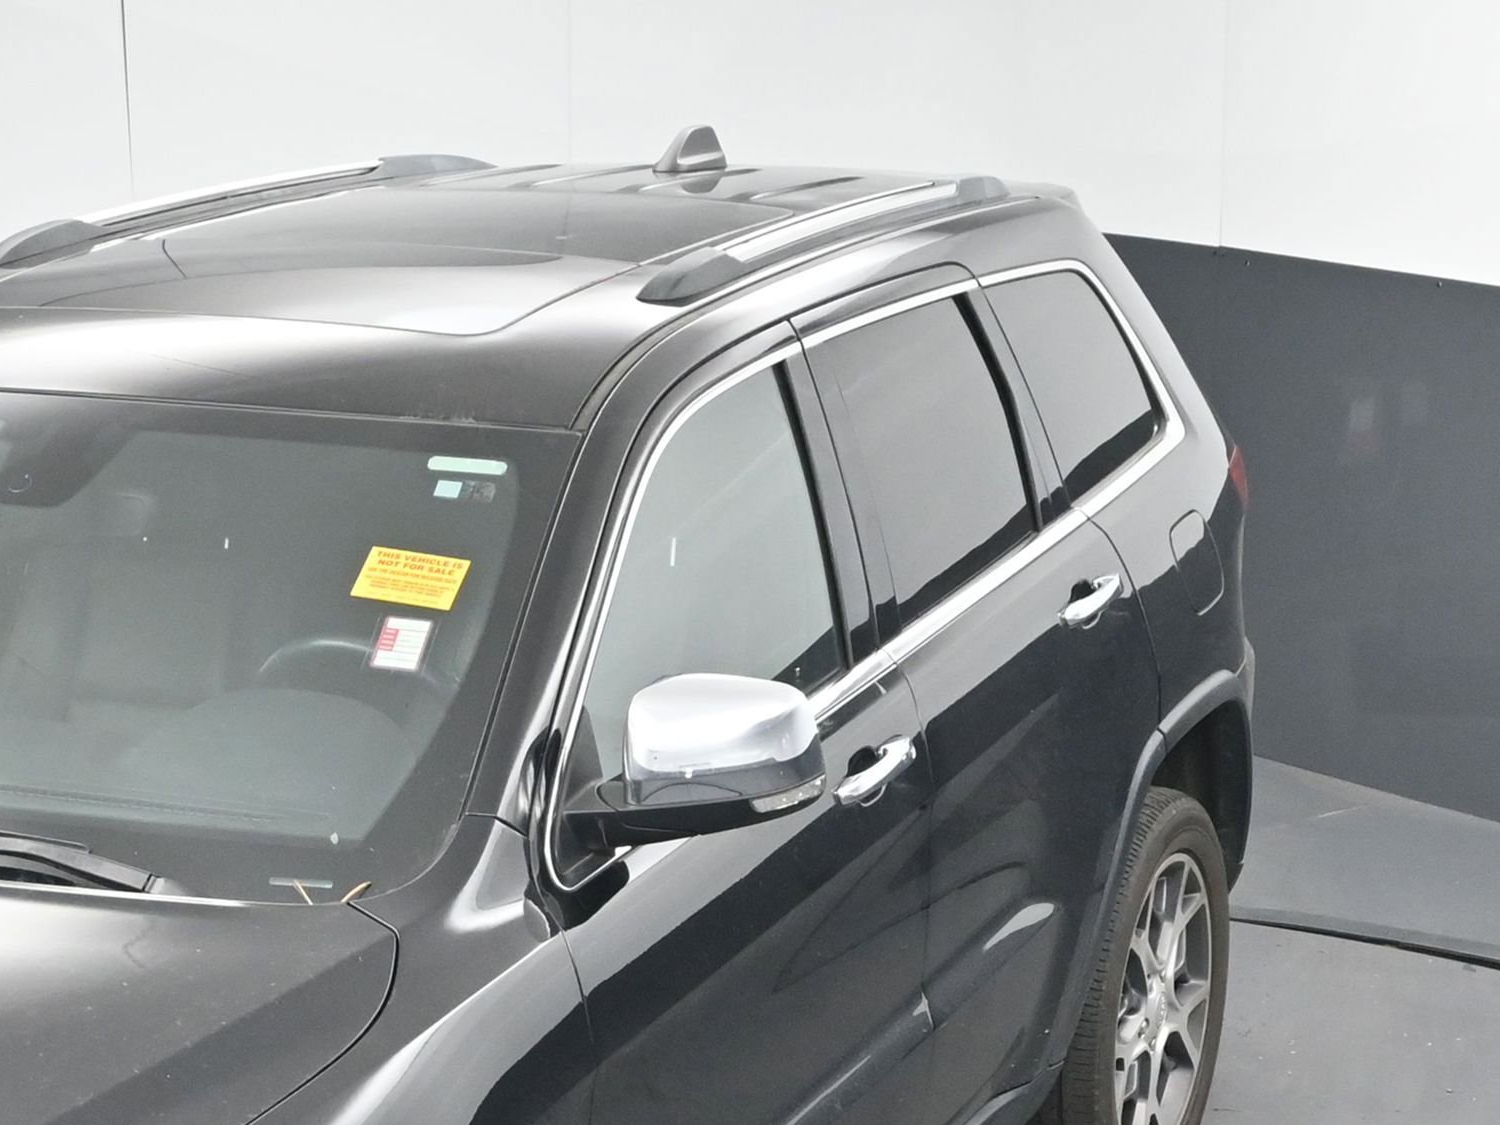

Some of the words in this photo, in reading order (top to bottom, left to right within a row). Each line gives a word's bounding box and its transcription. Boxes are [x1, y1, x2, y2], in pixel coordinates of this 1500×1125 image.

[377, 550, 401, 560] THIS
[404, 555, 450, 567] VEHICLE
[377, 559, 401, 567] NOT
[403, 562, 425, 571] FOR
[427, 566, 456, 576] SALE
